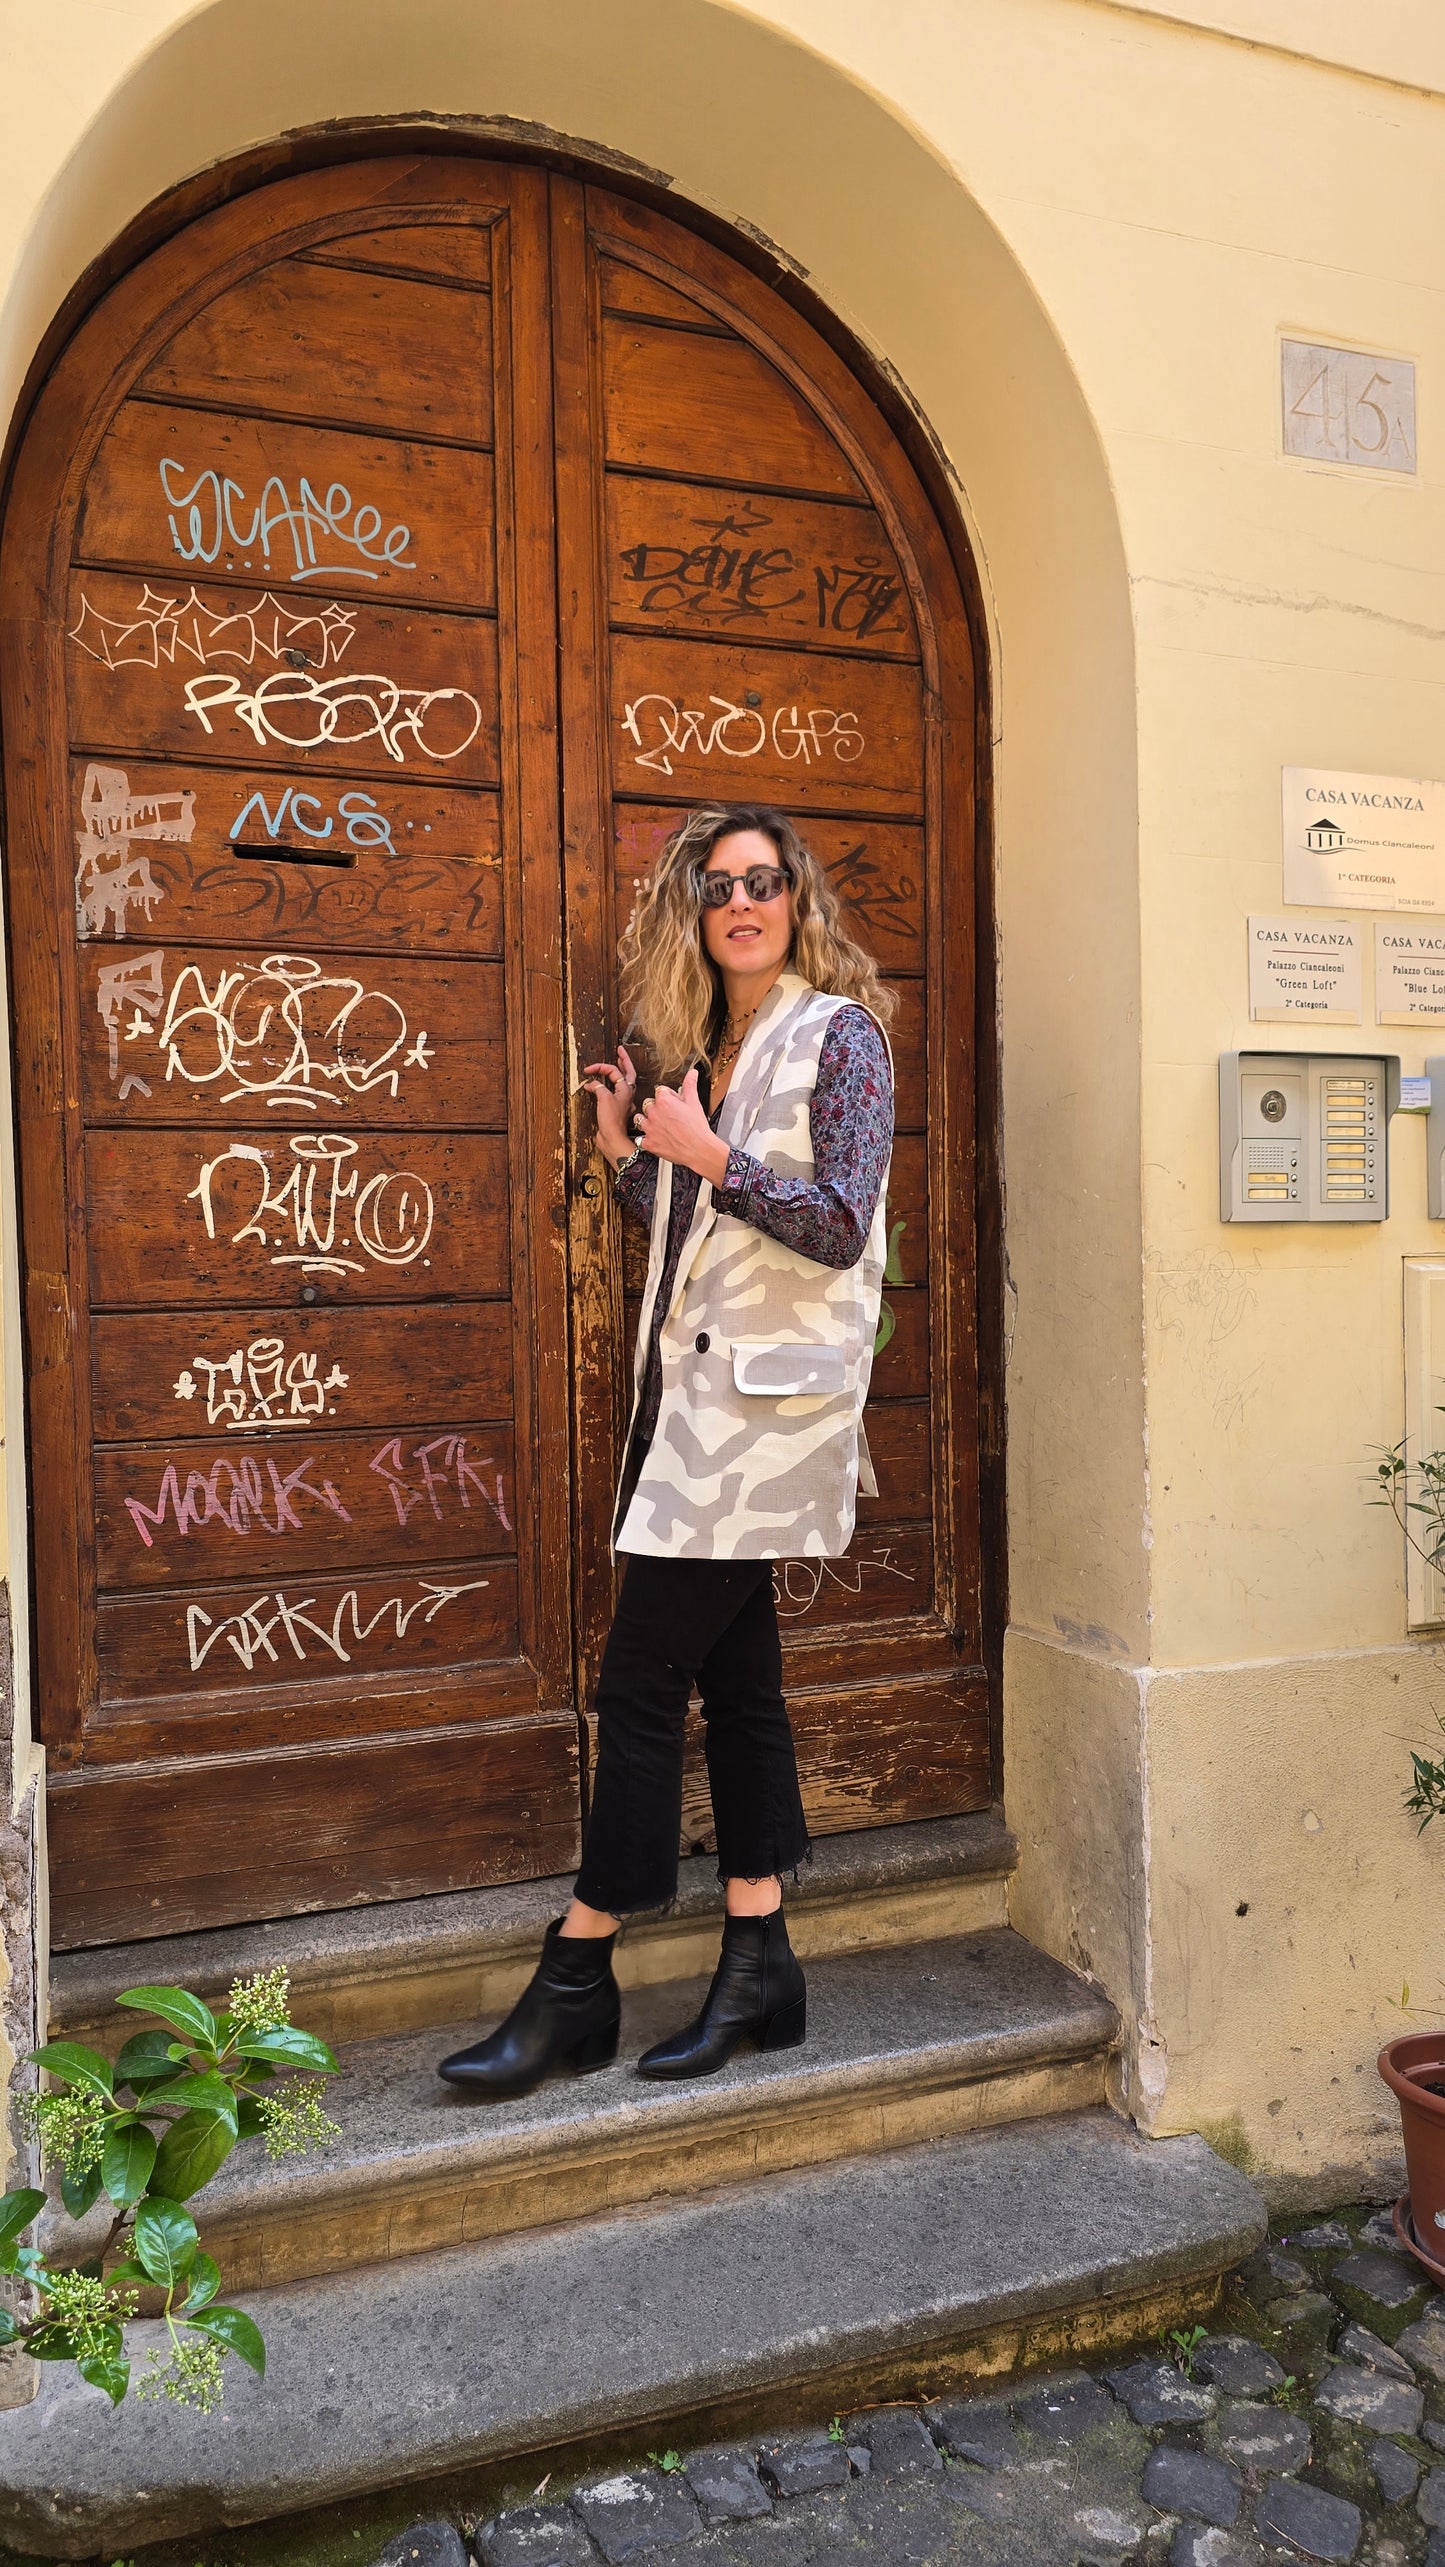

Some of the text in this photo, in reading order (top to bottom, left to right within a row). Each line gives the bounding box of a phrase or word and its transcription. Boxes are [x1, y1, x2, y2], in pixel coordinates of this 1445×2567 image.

[1305, 788, 1425, 811] CASA VACANZA
[1347, 837, 1380, 847] Domus
[1348, 874, 1396, 885] CATEGORIA
[1257, 931, 1354, 946] CASA VACANZA
[1383, 936, 1413, 948] CASA
[1267, 960, 1345, 973] Palazzo Ciancaleoni
[1393, 965, 1421, 975] Palazzo
[1276, 978, 1337, 990] "Green Loft"
[1295, 1000, 1328, 1009] Categoria
